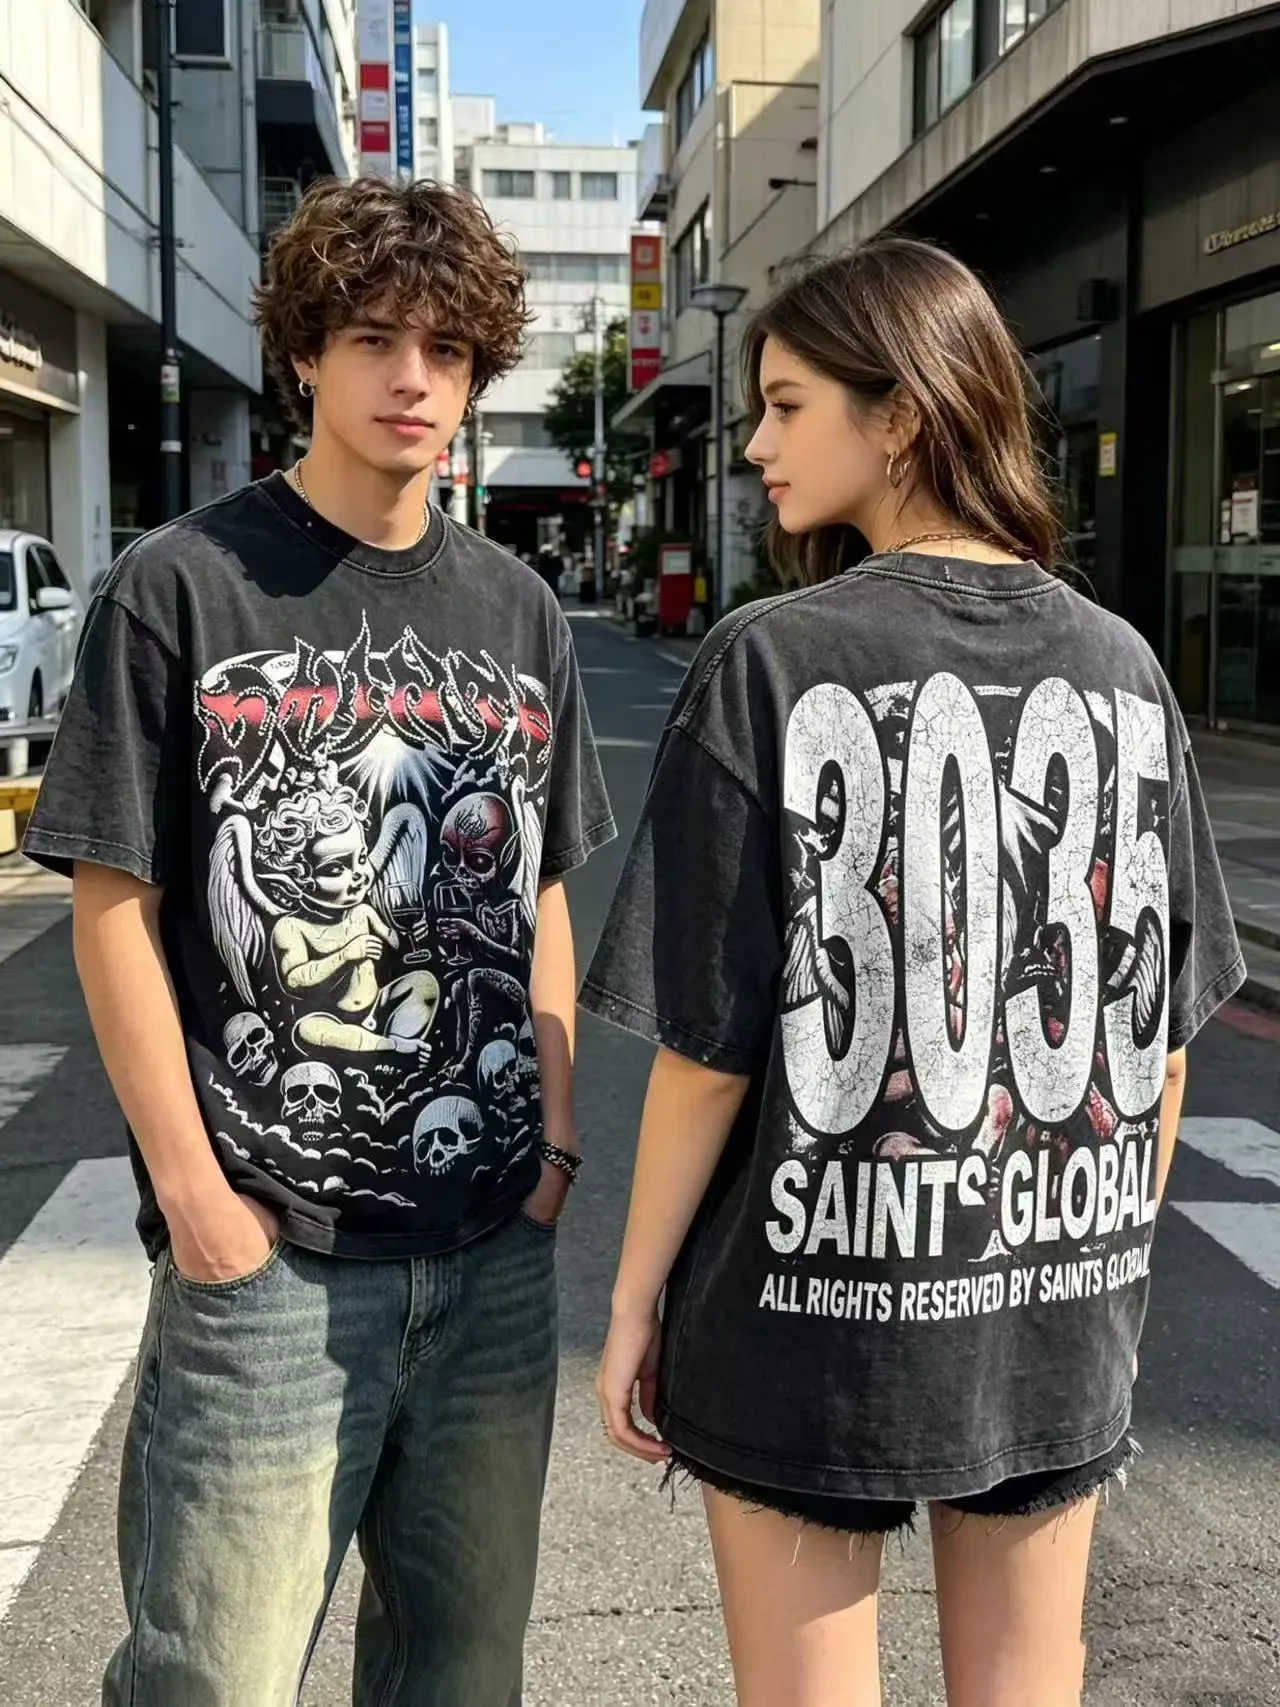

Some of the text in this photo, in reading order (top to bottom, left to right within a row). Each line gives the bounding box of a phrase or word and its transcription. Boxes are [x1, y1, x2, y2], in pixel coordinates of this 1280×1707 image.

[780, 671, 1170, 1134] 3035
[1001, 1138, 1156, 1247] GLOBAL
[759, 1273, 802, 1312] ALL
[806, 1277, 893, 1322] RIGHTS
[900, 1272, 1005, 1321] RESERVED
[1009, 1267, 1036, 1308] BY
[1039, 1258, 1103, 1303] SAINTS
